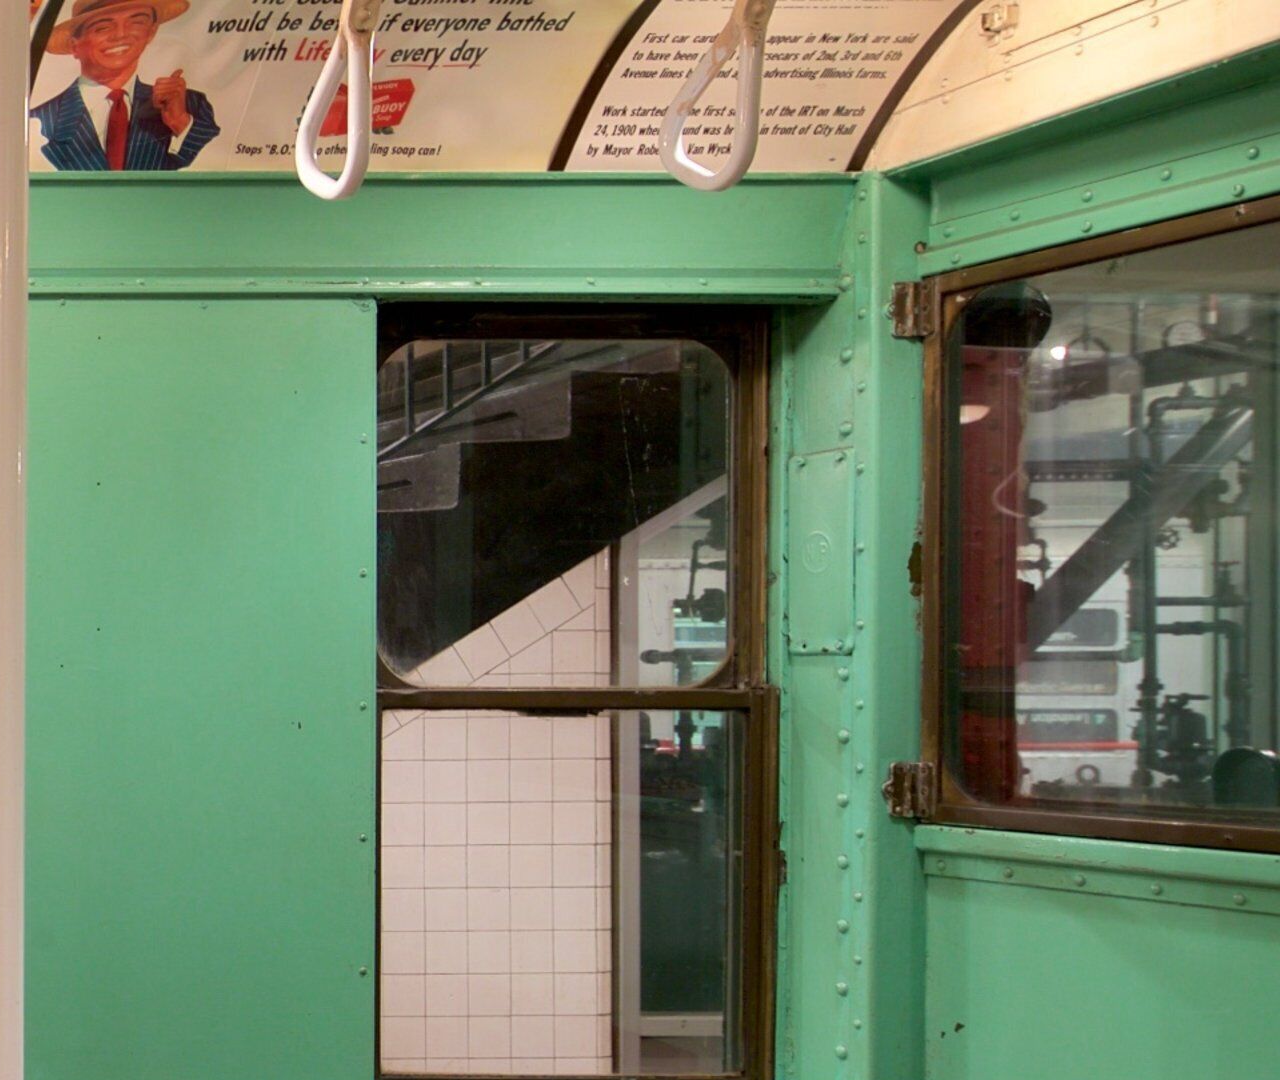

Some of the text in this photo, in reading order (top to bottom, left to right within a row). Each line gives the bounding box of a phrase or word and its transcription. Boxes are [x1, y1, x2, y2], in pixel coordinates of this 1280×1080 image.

[208, 11, 576, 38] would be if everyone bathed
[643, 33, 920, 46] First appear New York said
[243, 37, 488, 70] with Lifey every day
[646, 50, 670, 61] have
[673, 50, 699, 61] been
[620, 68, 888, 81] Avenue lines advertising Illinois farms.
[373, 101, 406, 113] BUOY
[602, 106, 866, 117] Work started first March
[610, 124, 858, 138] 1900 front City Hall
[235, 143, 443, 156] Stops soap can!
[602, 144, 732, 158] Mayor Wyck
